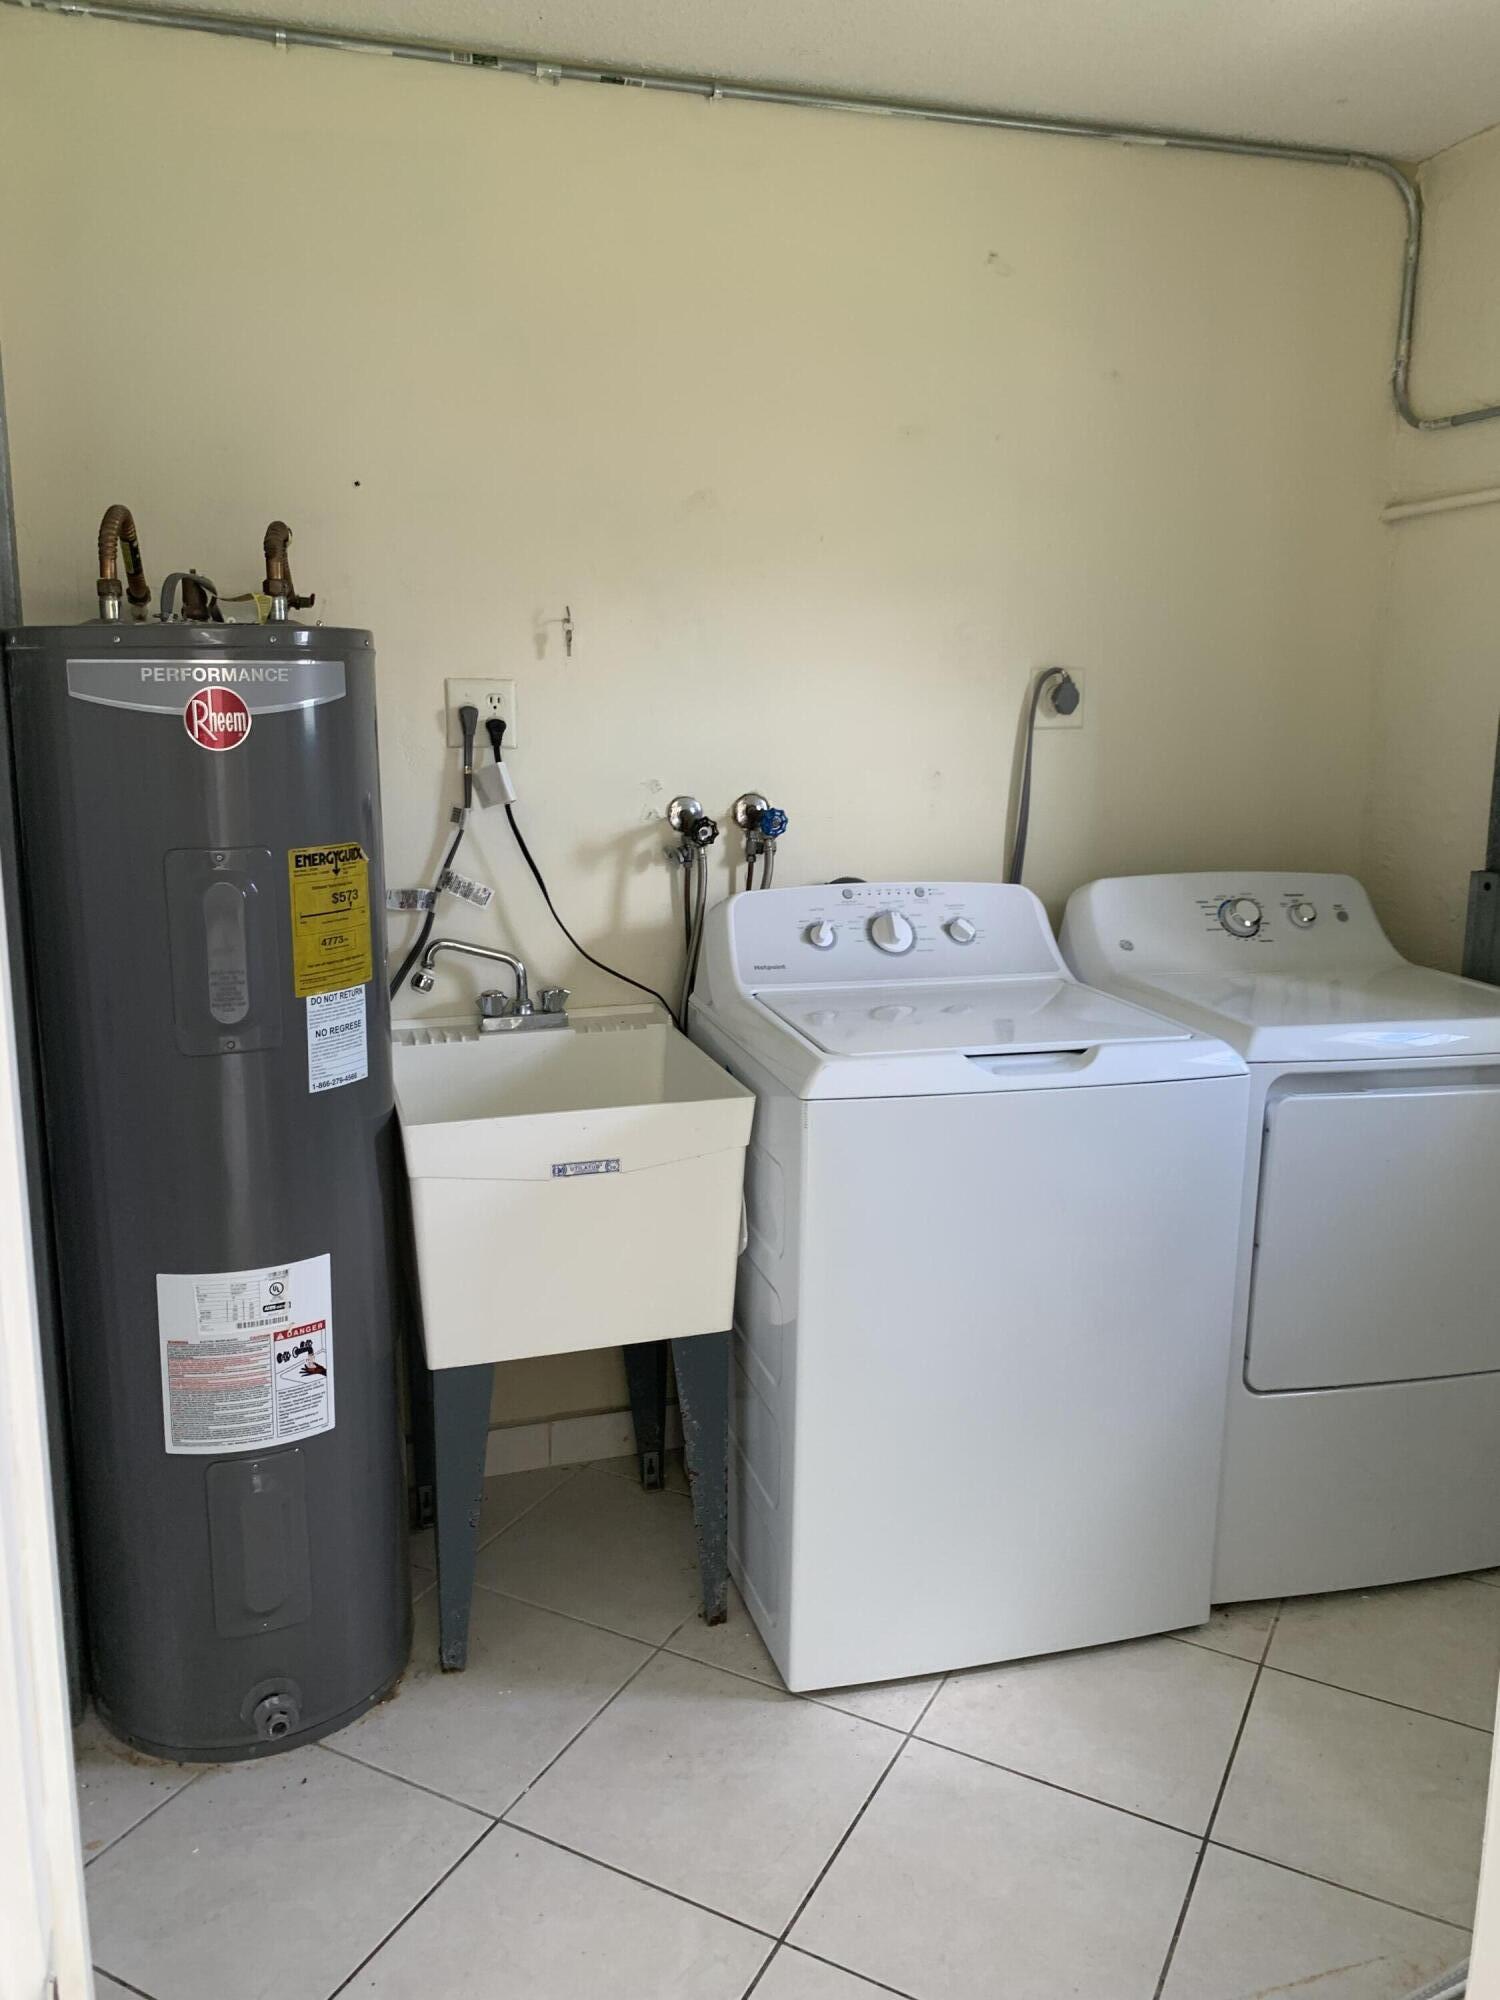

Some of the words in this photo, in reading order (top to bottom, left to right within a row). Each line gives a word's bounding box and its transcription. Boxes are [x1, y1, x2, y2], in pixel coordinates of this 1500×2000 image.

[140, 667, 289, 682] PERFORMANCE
[191, 688, 246, 741] Rheem
[331, 889, 359, 904] $573
[310, 997, 322, 1006] DO
[323, 993, 338, 1003] NOT
[340, 987, 363, 1000] RETURN
[315, 1028, 328, 1038] NO
[329, 1019, 362, 1036] REGRESE
[287, 1322, 324, 1337] DANGER
